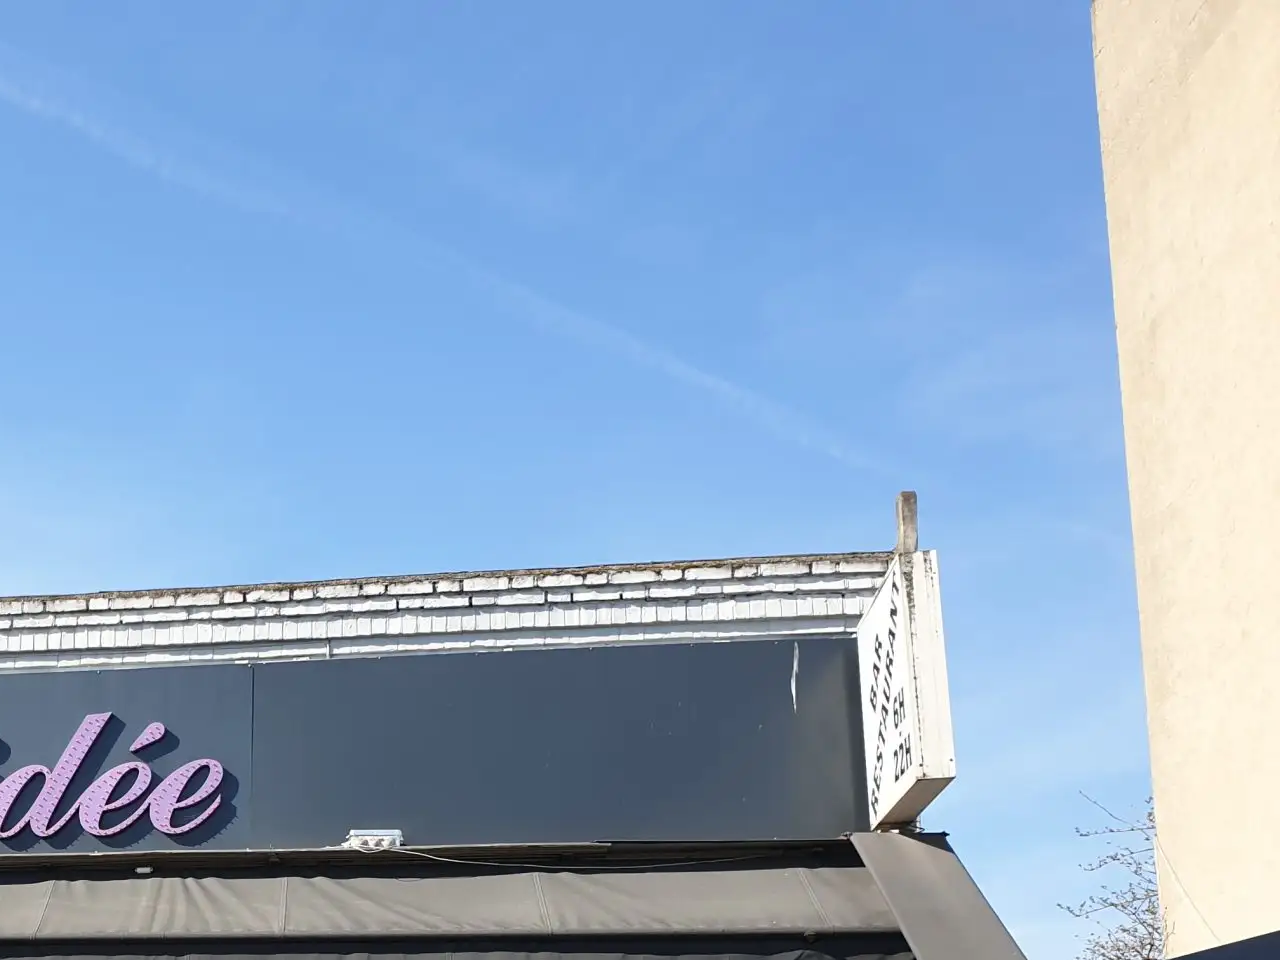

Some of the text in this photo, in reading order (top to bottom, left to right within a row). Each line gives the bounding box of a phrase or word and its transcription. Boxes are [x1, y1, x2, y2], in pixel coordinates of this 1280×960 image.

[870, 633, 883, 713] BAR
[871, 569, 900, 819] RESTAURANT
[893, 686, 906, 730] 6H
[893, 733, 913, 784] 22H
